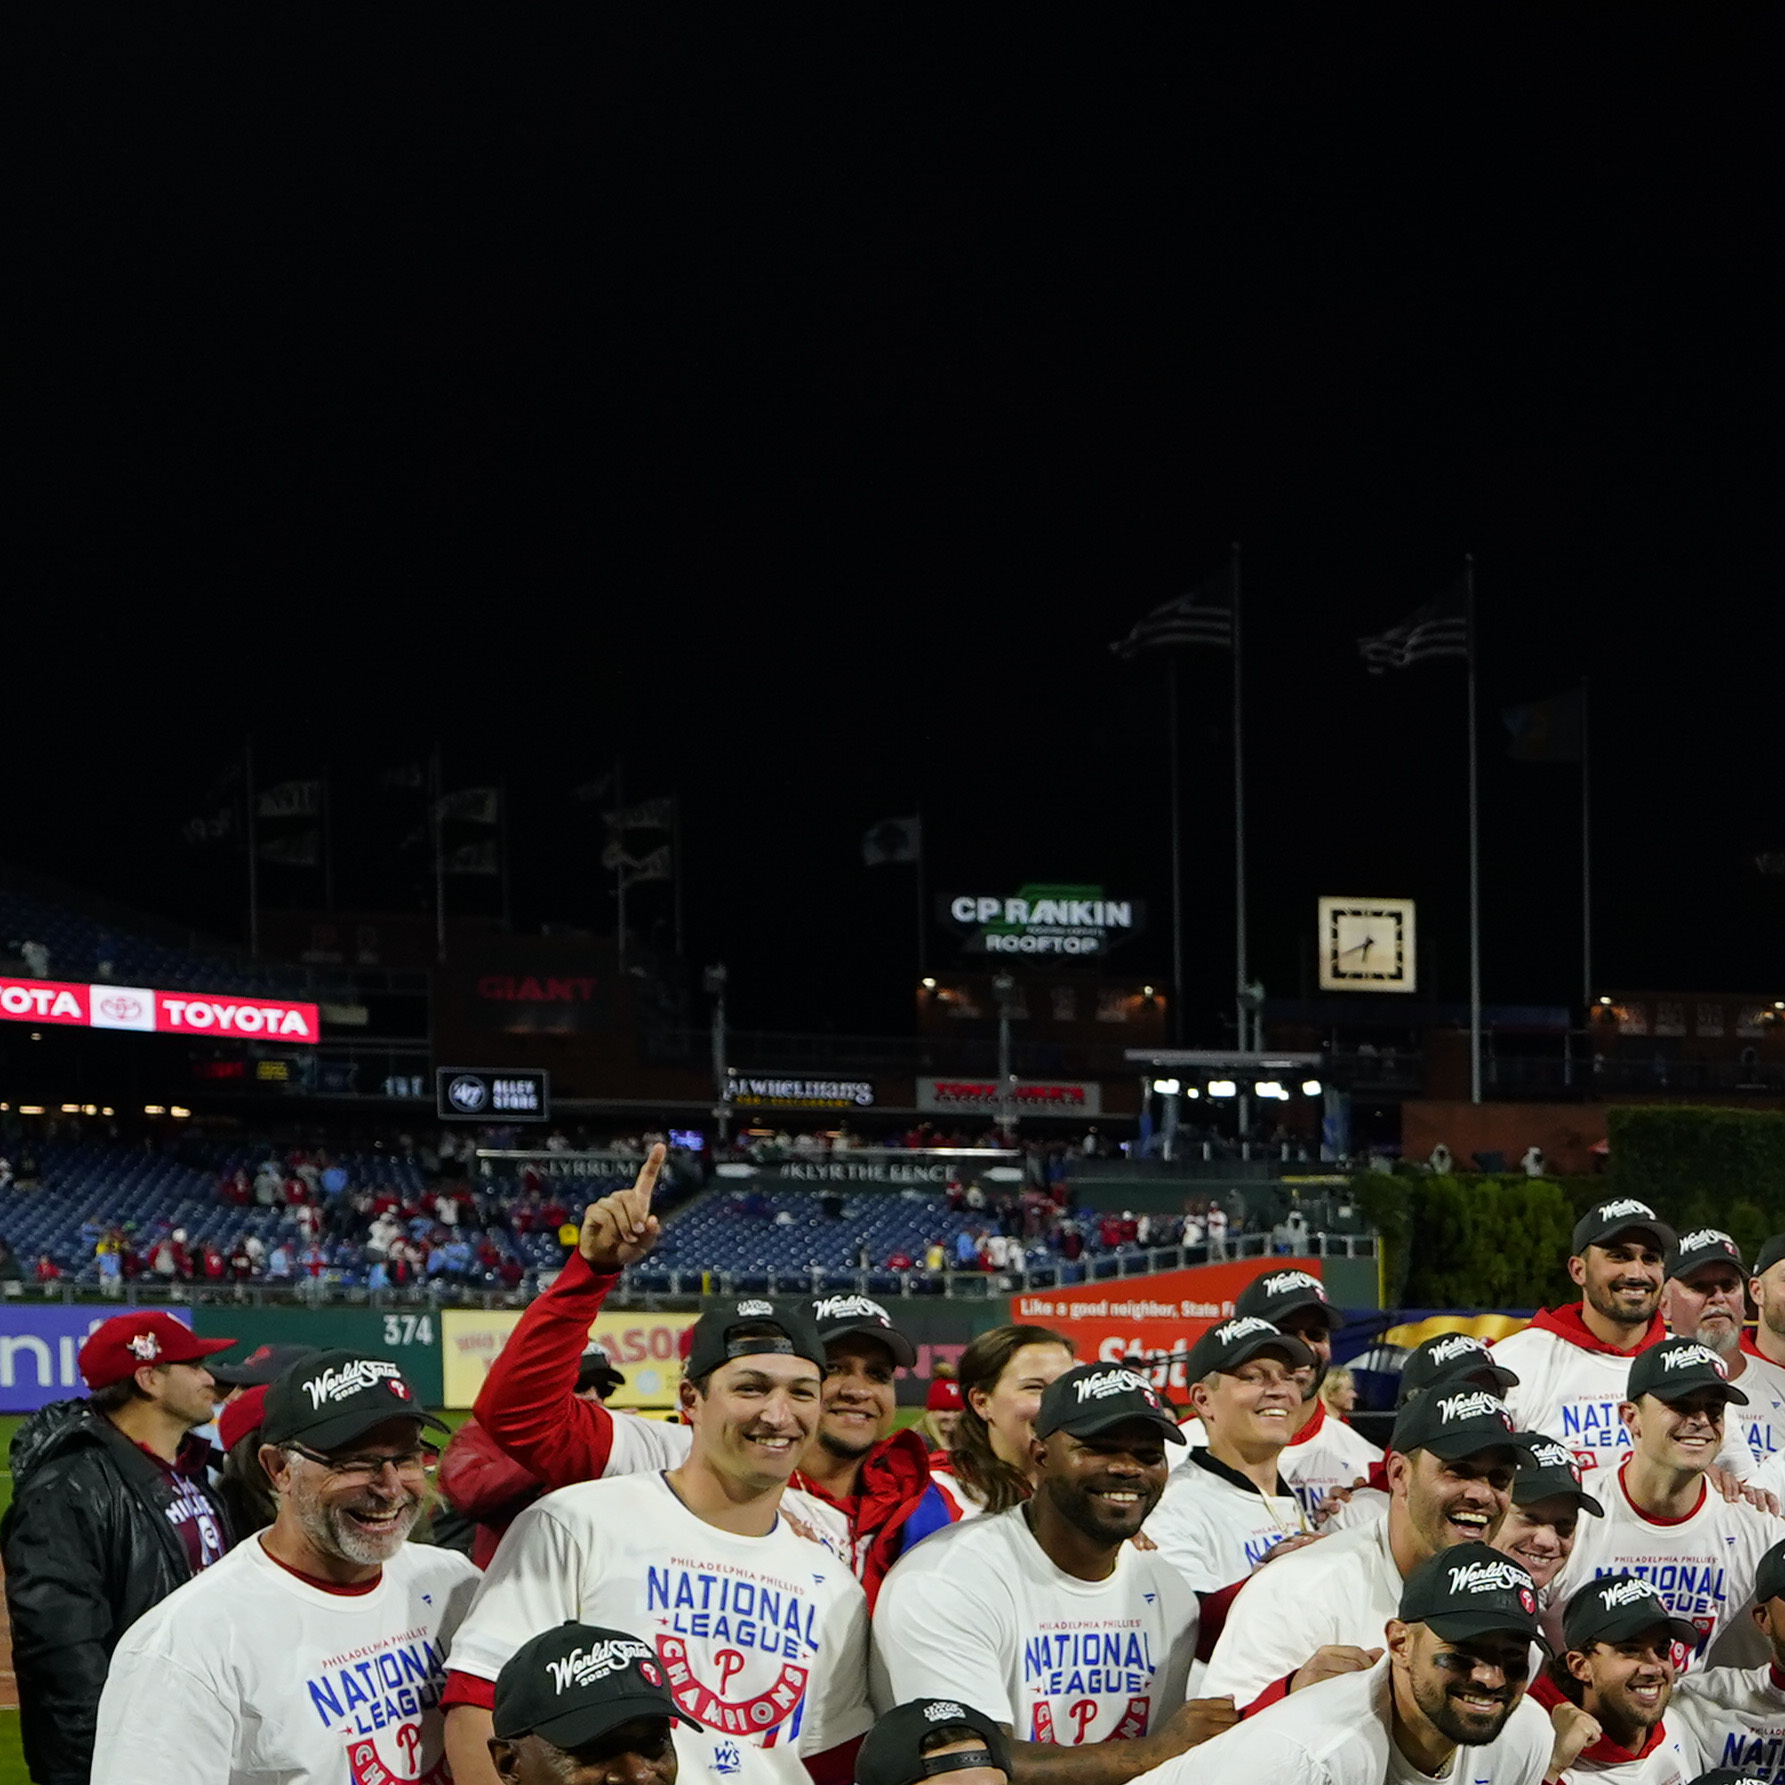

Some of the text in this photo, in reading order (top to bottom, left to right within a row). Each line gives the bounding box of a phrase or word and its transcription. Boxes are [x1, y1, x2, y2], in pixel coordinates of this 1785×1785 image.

[985, 934, 1100, 954] ROOFTOP
[477, 976, 599, 1001] GIANT
[162, 999, 310, 1037] TOYOTA
[383, 1314, 434, 1346] 374
[1020, 1298, 1052, 1317] Like
[1056, 1303, 1067, 1317] a
[1069, 1302, 1109, 1319] good
[1110, 1299, 1178, 1318] neighbor,
[1181, 1300, 1219, 1317] State
[1098, 1337, 1187, 1389] Stat
[304, 1361, 361, 1410] World
[1448, 1561, 1491, 1597] World
[648, 1565, 819, 1652] NATIONAL
[673, 1612, 798, 1660] LEAGUE
[1024, 1632, 1156, 1680] NATIONAL
[307, 1639, 449, 1728] NATIONA
[546, 1645, 611, 1695] World
[1042, 1669, 1142, 1696] LEAGUE
